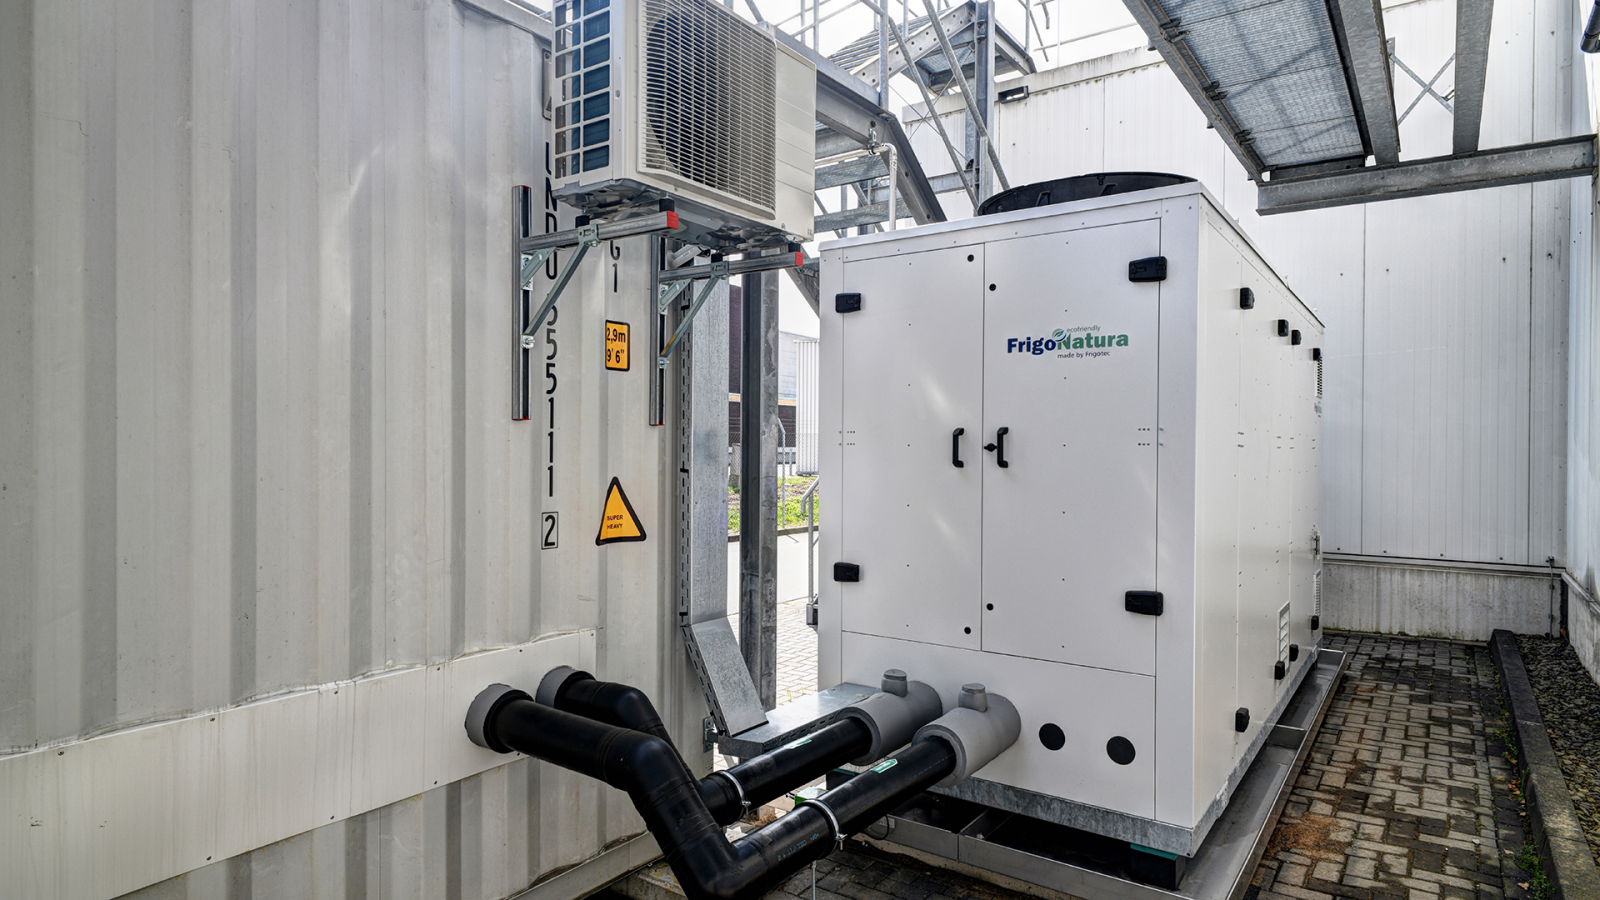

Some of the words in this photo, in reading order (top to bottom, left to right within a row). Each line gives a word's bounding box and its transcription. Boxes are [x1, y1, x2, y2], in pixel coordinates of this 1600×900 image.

[1066, 325, 1101, 333] ecofriendly
[1007, 333, 1129, 355] FrigoNatura
[1076, 351, 1084, 359] by
[1085, 350, 1111, 359] Frigotec
[543, 514, 556, 547] 2
